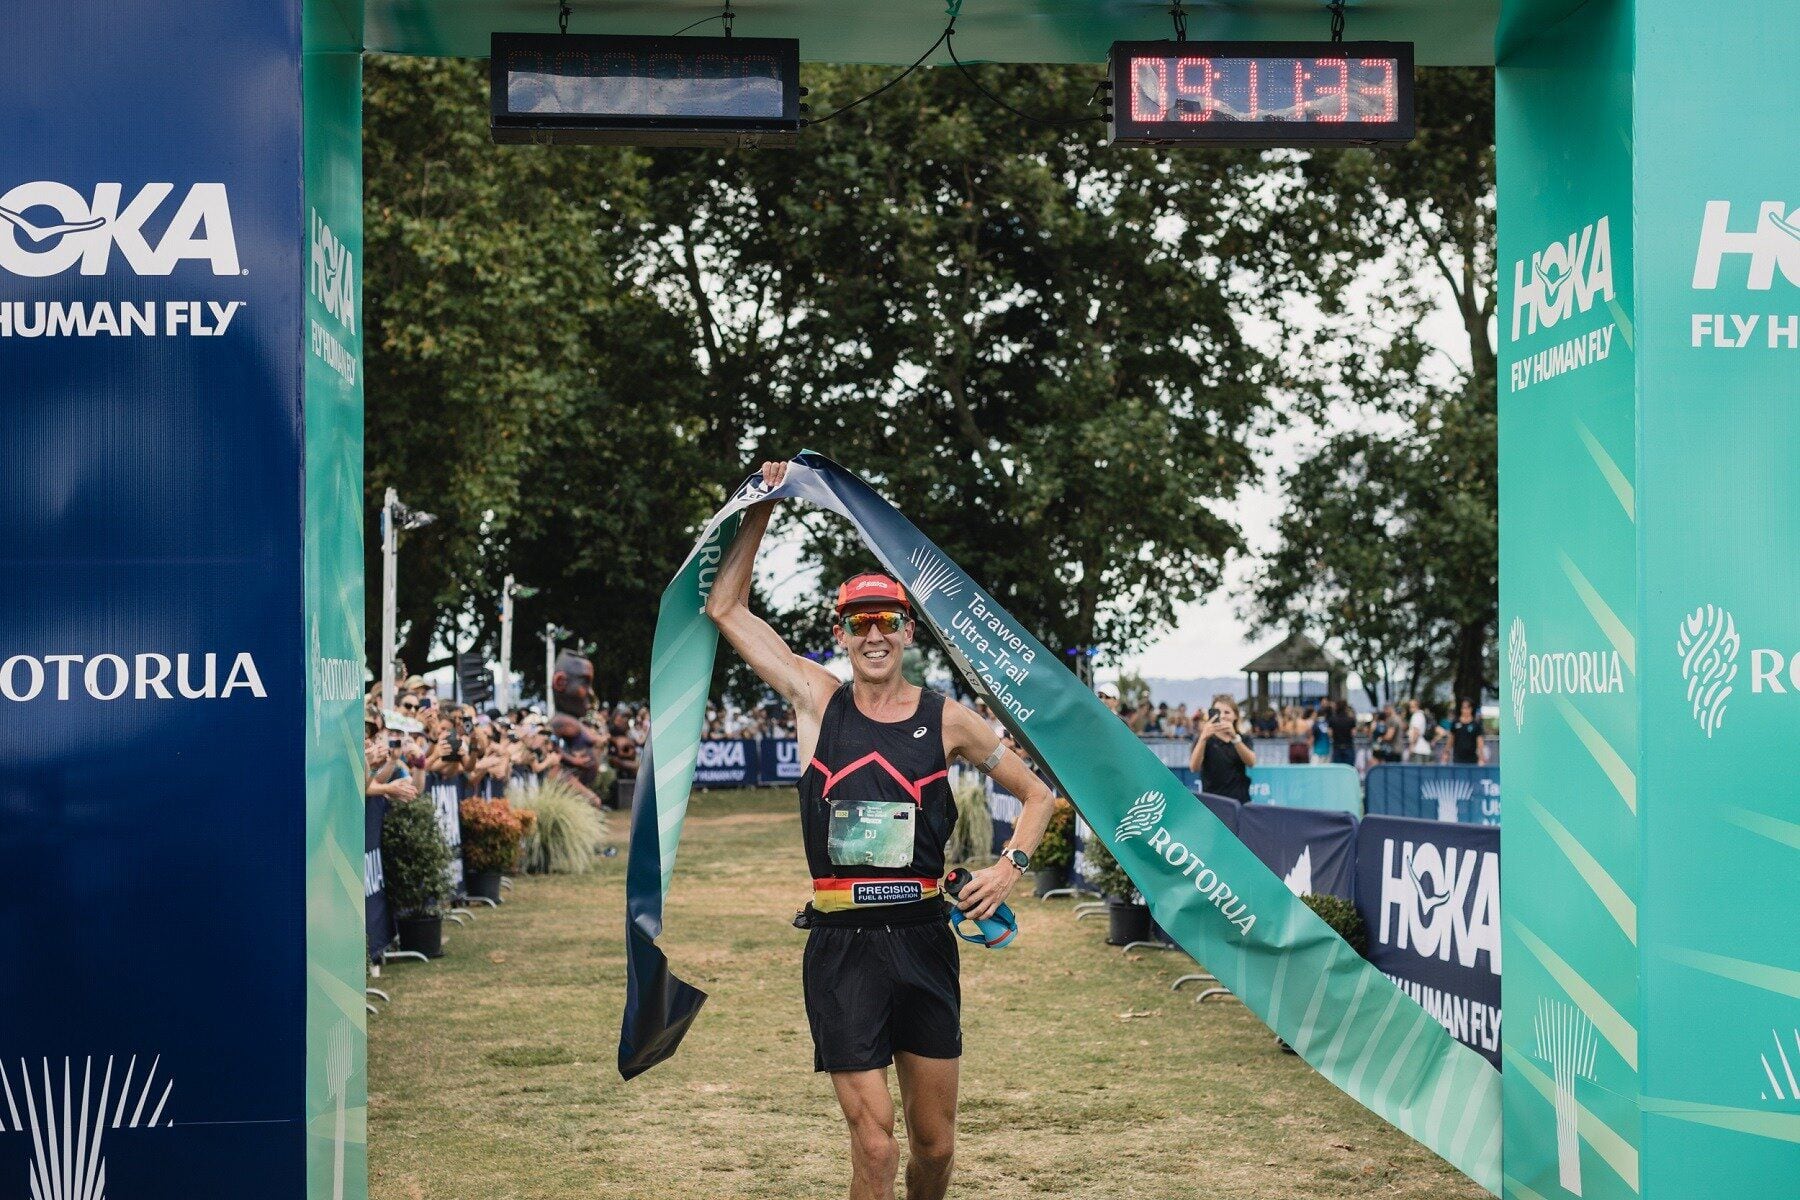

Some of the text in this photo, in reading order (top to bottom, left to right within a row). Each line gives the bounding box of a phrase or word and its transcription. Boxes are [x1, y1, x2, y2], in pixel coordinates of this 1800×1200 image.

[1131, 57, 1394, 122] 09:11:33
[0, 181, 240, 277] OKA
[311, 206, 356, 336] HOKA
[1511, 215, 1614, 342] HOKA
[166, 302, 240, 336] FLY
[1692, 314, 1760, 348] FLY
[1511, 324, 1613, 393] FLY HUMAN FLY
[951, 610, 1030, 687] Ultra-Trail
[967, 592, 1036, 665] Tarawera
[0, 652, 268, 702] OTORUA
[320, 657, 361, 700] ROTORUA
[1529, 651, 1624, 694] ROTORUA
[865, 829, 877, 839] DJ
[865, 851, 874, 862] 2
[858, 885, 919, 895] PRECISION
[1147, 826, 1257, 937] ROTORUA
[1379, 838, 1502, 976] HOKA
[1470, 1001, 1502, 1053] FLY
